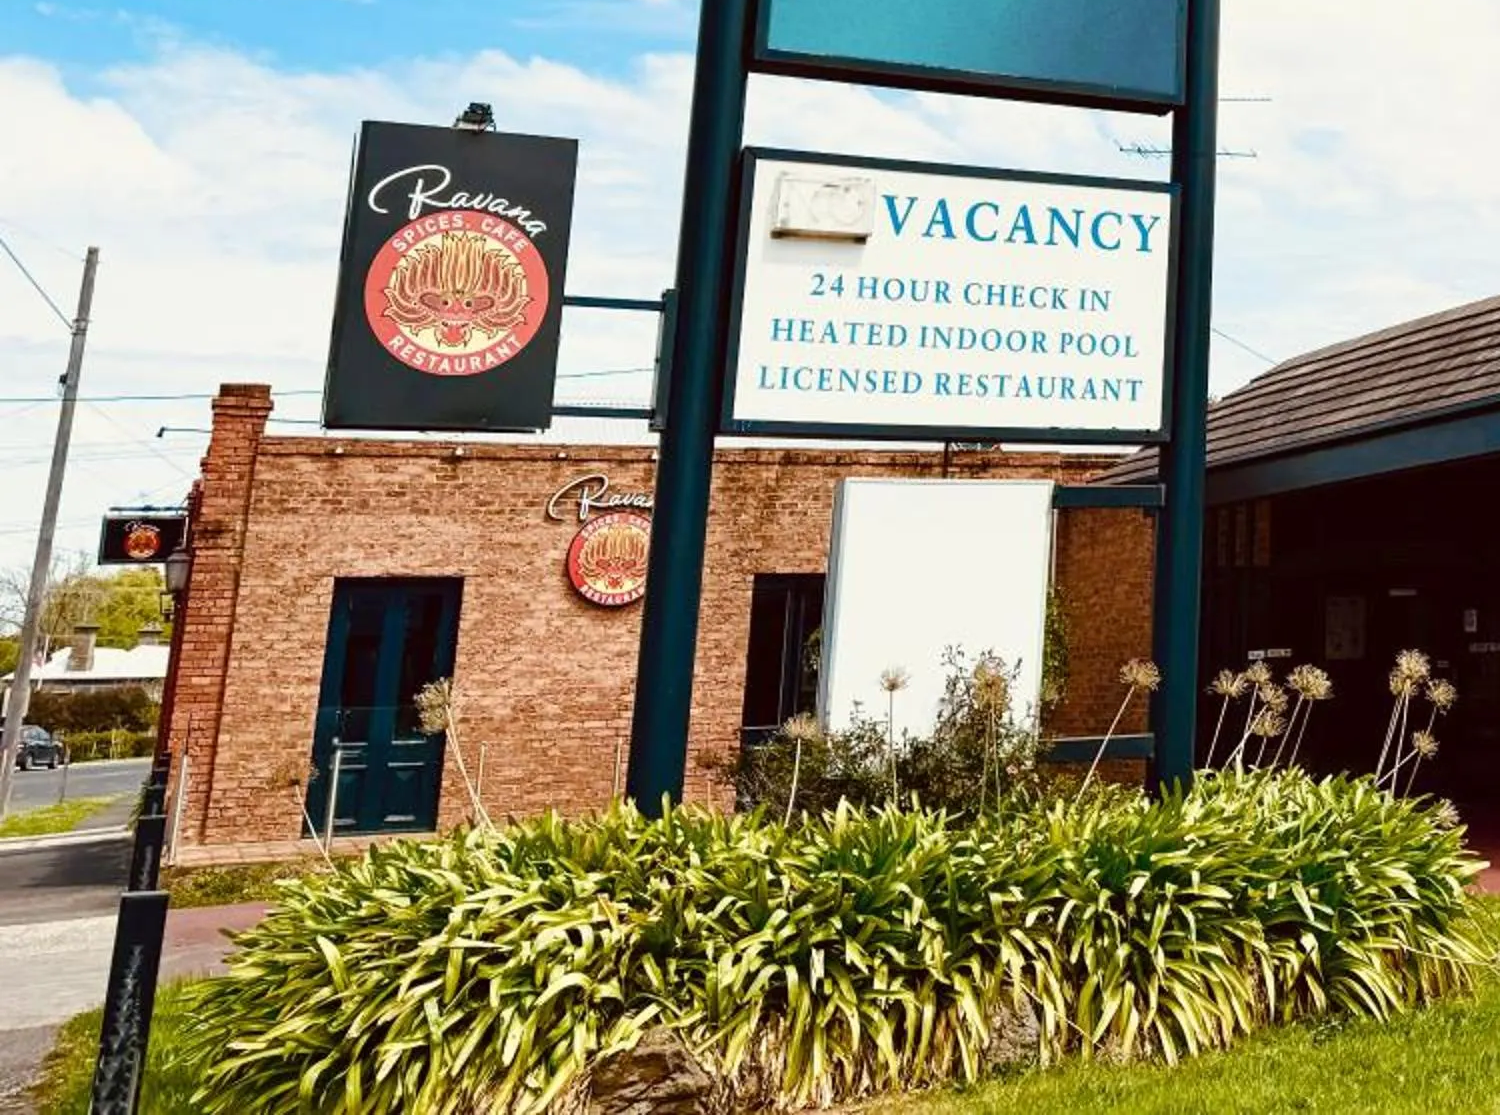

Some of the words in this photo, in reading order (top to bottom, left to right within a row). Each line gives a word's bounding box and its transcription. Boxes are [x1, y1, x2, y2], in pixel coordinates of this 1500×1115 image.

[367, 164, 547, 236] Ravana
[481, 218, 528, 252] CAFE
[881, 194, 1161, 254] VACANCY
[810, 272, 845, 298] 24
[857, 276, 952, 304] HOUR
[963, 282, 1069, 310] CHECK
[1078, 288, 1112, 312] IN
[389, 334, 520, 373] RESTAURANT
[771, 317, 908, 348] HEATED
[918, 325, 1049, 355] INDOOR
[1059, 332, 1139, 359] POOL
[759, 365, 923, 395] LICENSED
[934, 372, 1144, 403] RESTAURANT
[548, 474, 654, 521] Rava
